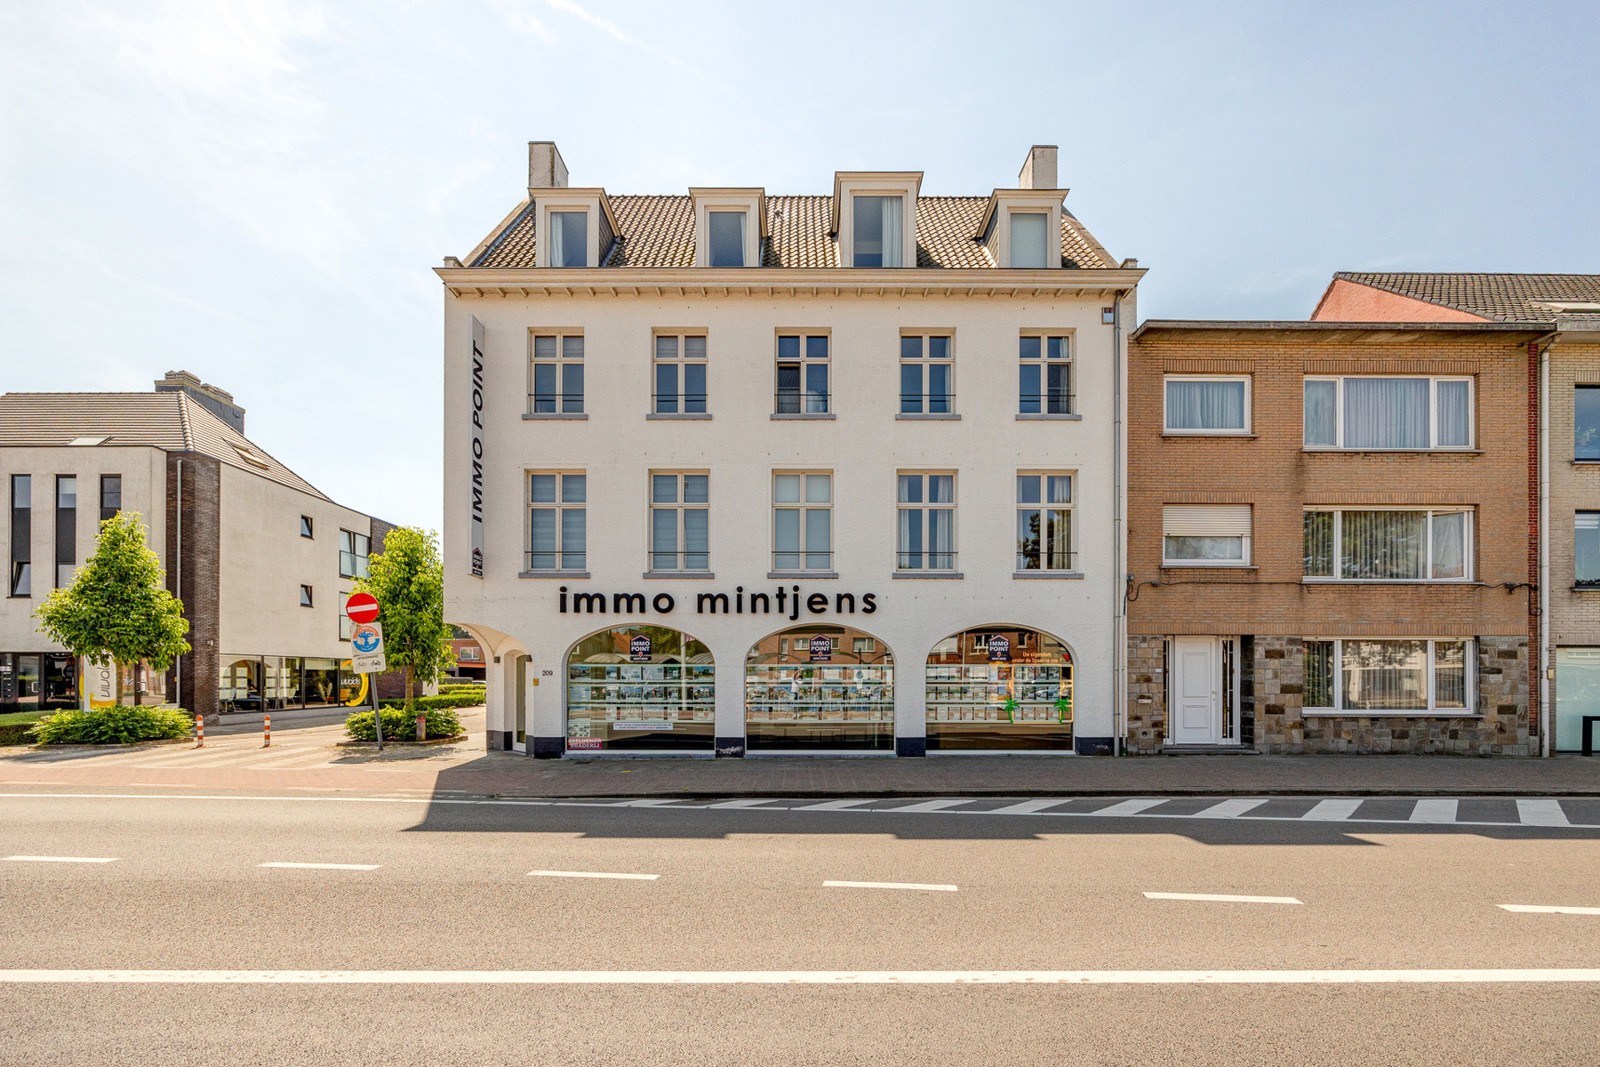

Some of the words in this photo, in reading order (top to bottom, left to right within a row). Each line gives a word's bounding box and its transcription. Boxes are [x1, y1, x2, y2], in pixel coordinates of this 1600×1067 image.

[472, 339, 484, 430] POINT
[472, 437, 483, 523] IMMO
[559, 586, 675, 613] immo
[697, 585, 877, 621] mintjens
